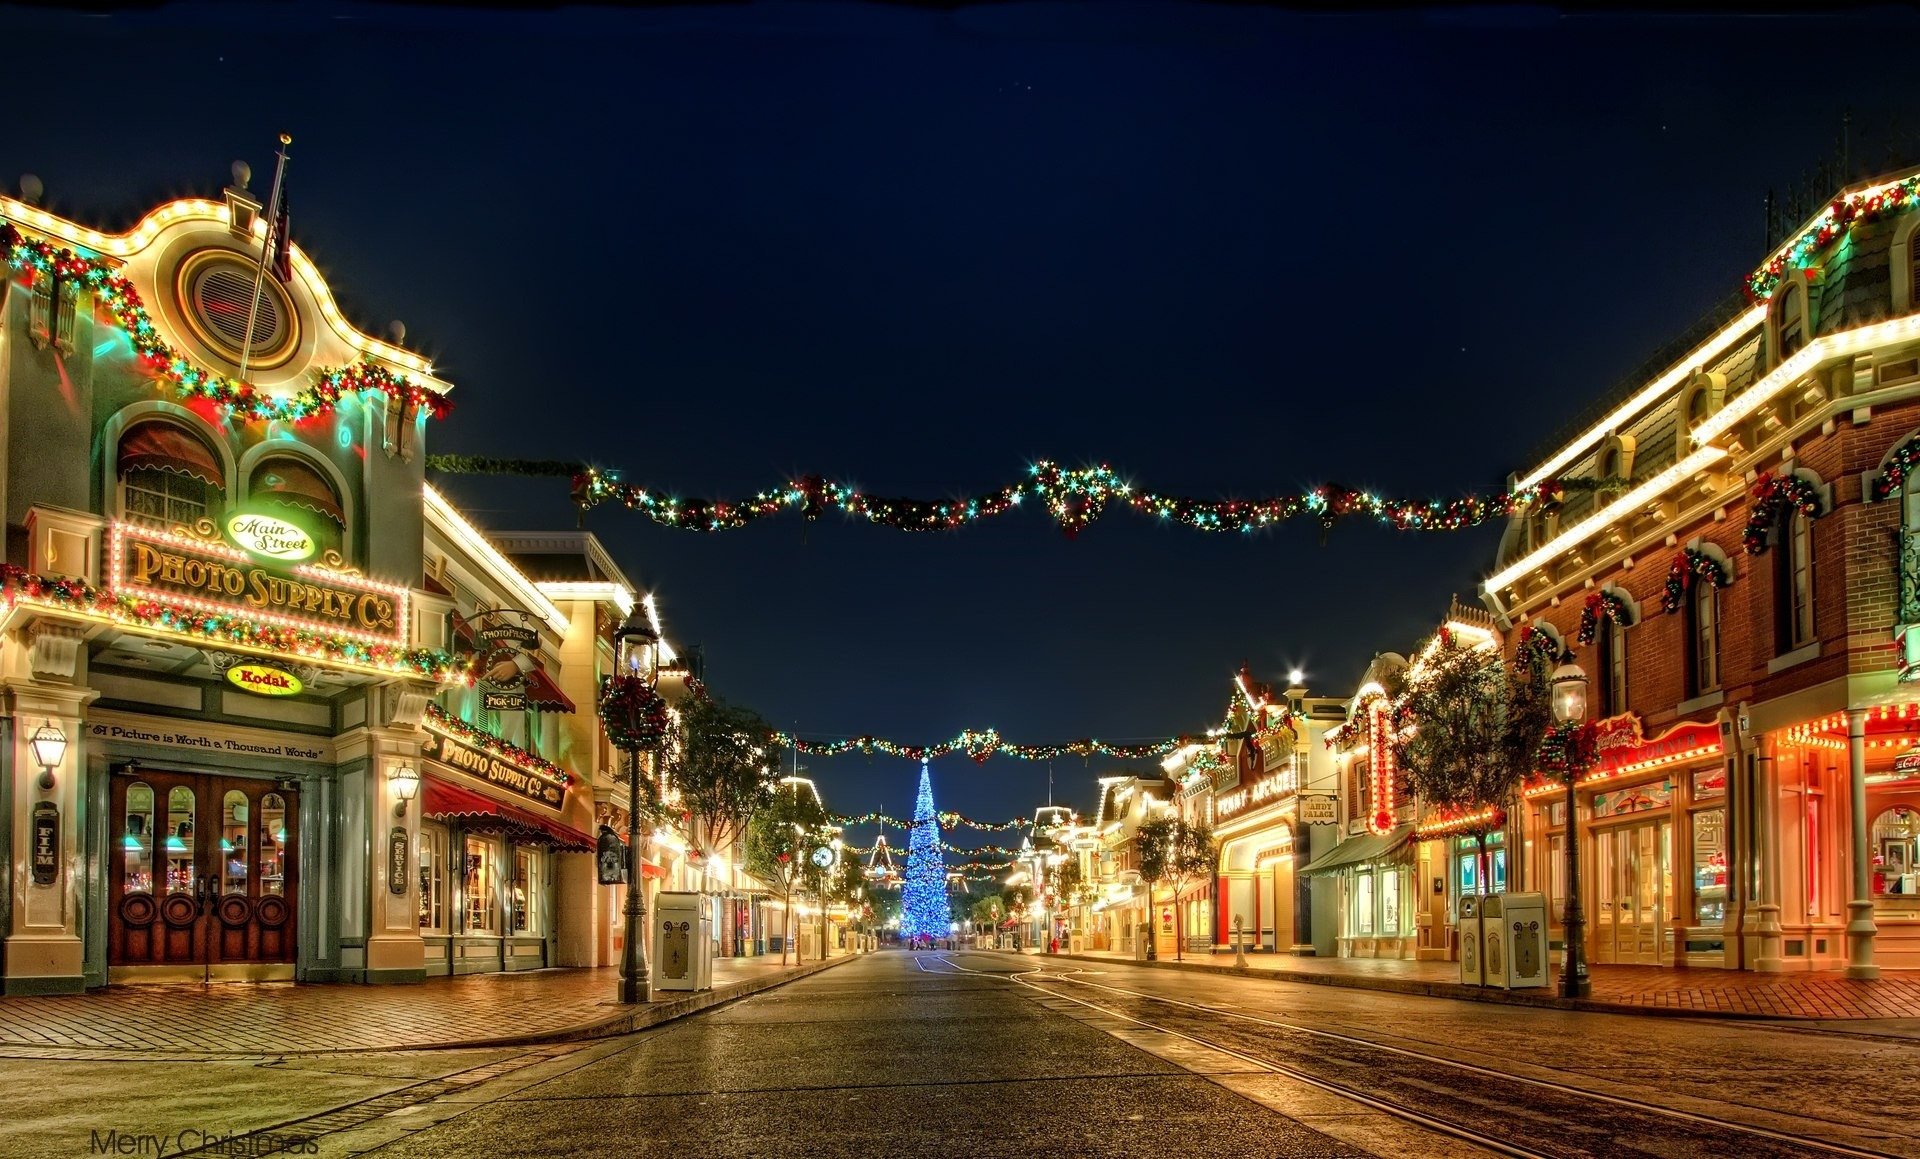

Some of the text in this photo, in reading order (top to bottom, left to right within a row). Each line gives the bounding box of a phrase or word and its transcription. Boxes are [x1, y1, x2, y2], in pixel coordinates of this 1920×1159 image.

[233, 519, 298, 536] Main
[254, 535, 308, 553] Street
[134, 542, 245, 596] PHOTO
[245, 569, 356, 619] SUPPLY
[241, 670, 289, 688] Kodak
[487, 697, 522, 706] PICK-UP
[112, 727, 160, 742] Picture
[163, 734, 174, 743] is
[175, 734, 211, 748] Worth
[214, 741, 223, 749] a
[224, 740, 281, 755] Thousand
[440, 738, 488, 773] PHOTO
[489, 760, 528, 789] SUPPLY
[37, 827, 54, 865] FILM
[394, 841, 405, 885] SERVICE
